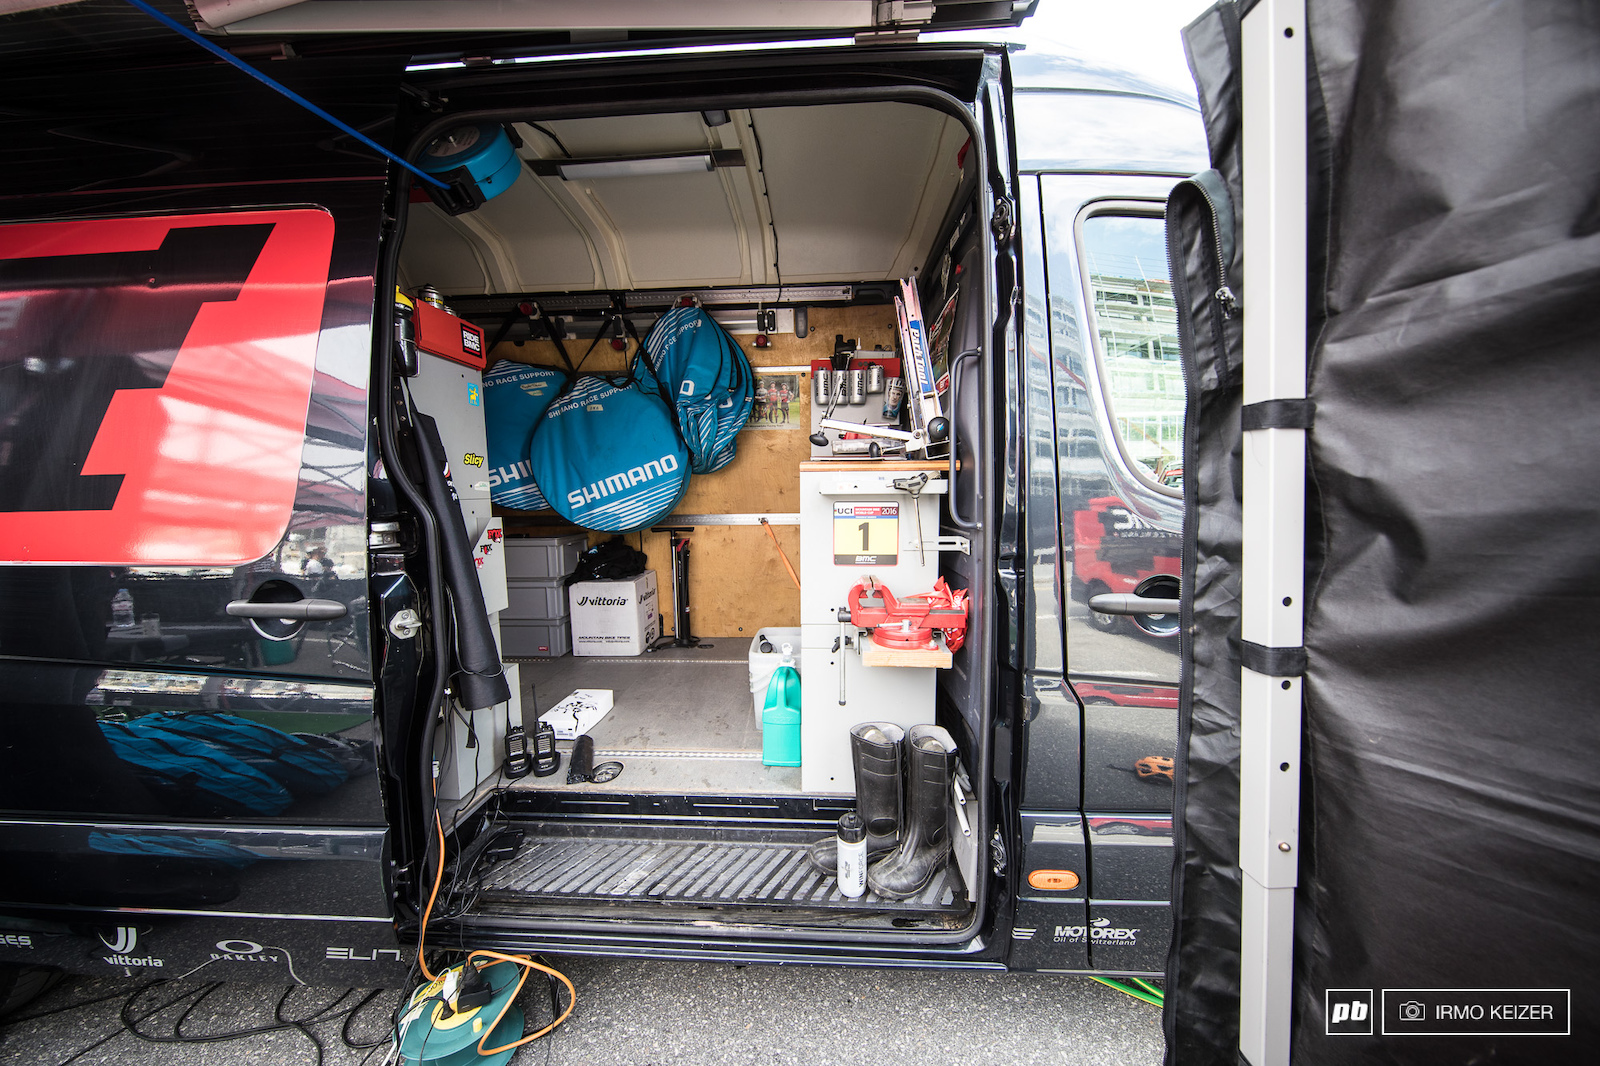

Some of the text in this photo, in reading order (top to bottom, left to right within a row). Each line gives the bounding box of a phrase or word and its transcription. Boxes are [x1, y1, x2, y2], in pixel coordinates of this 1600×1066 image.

[462, 330, 480, 344] RIDE
[463, 338, 481, 352] BMC
[495, 375, 518, 385] RACE
[519, 371, 555, 380] SUPPORT
[580, 394, 599, 407] RACE
[463, 453, 484, 468] Slicy
[567, 454, 680, 510] SHIMANO
[881, 507, 898, 515] 2016
[858, 522, 869, 551] 1
[589, 596, 626, 606] vittoria
[1053, 925, 1137, 940] MOTOREX
[103, 954, 164, 967] vittoria
